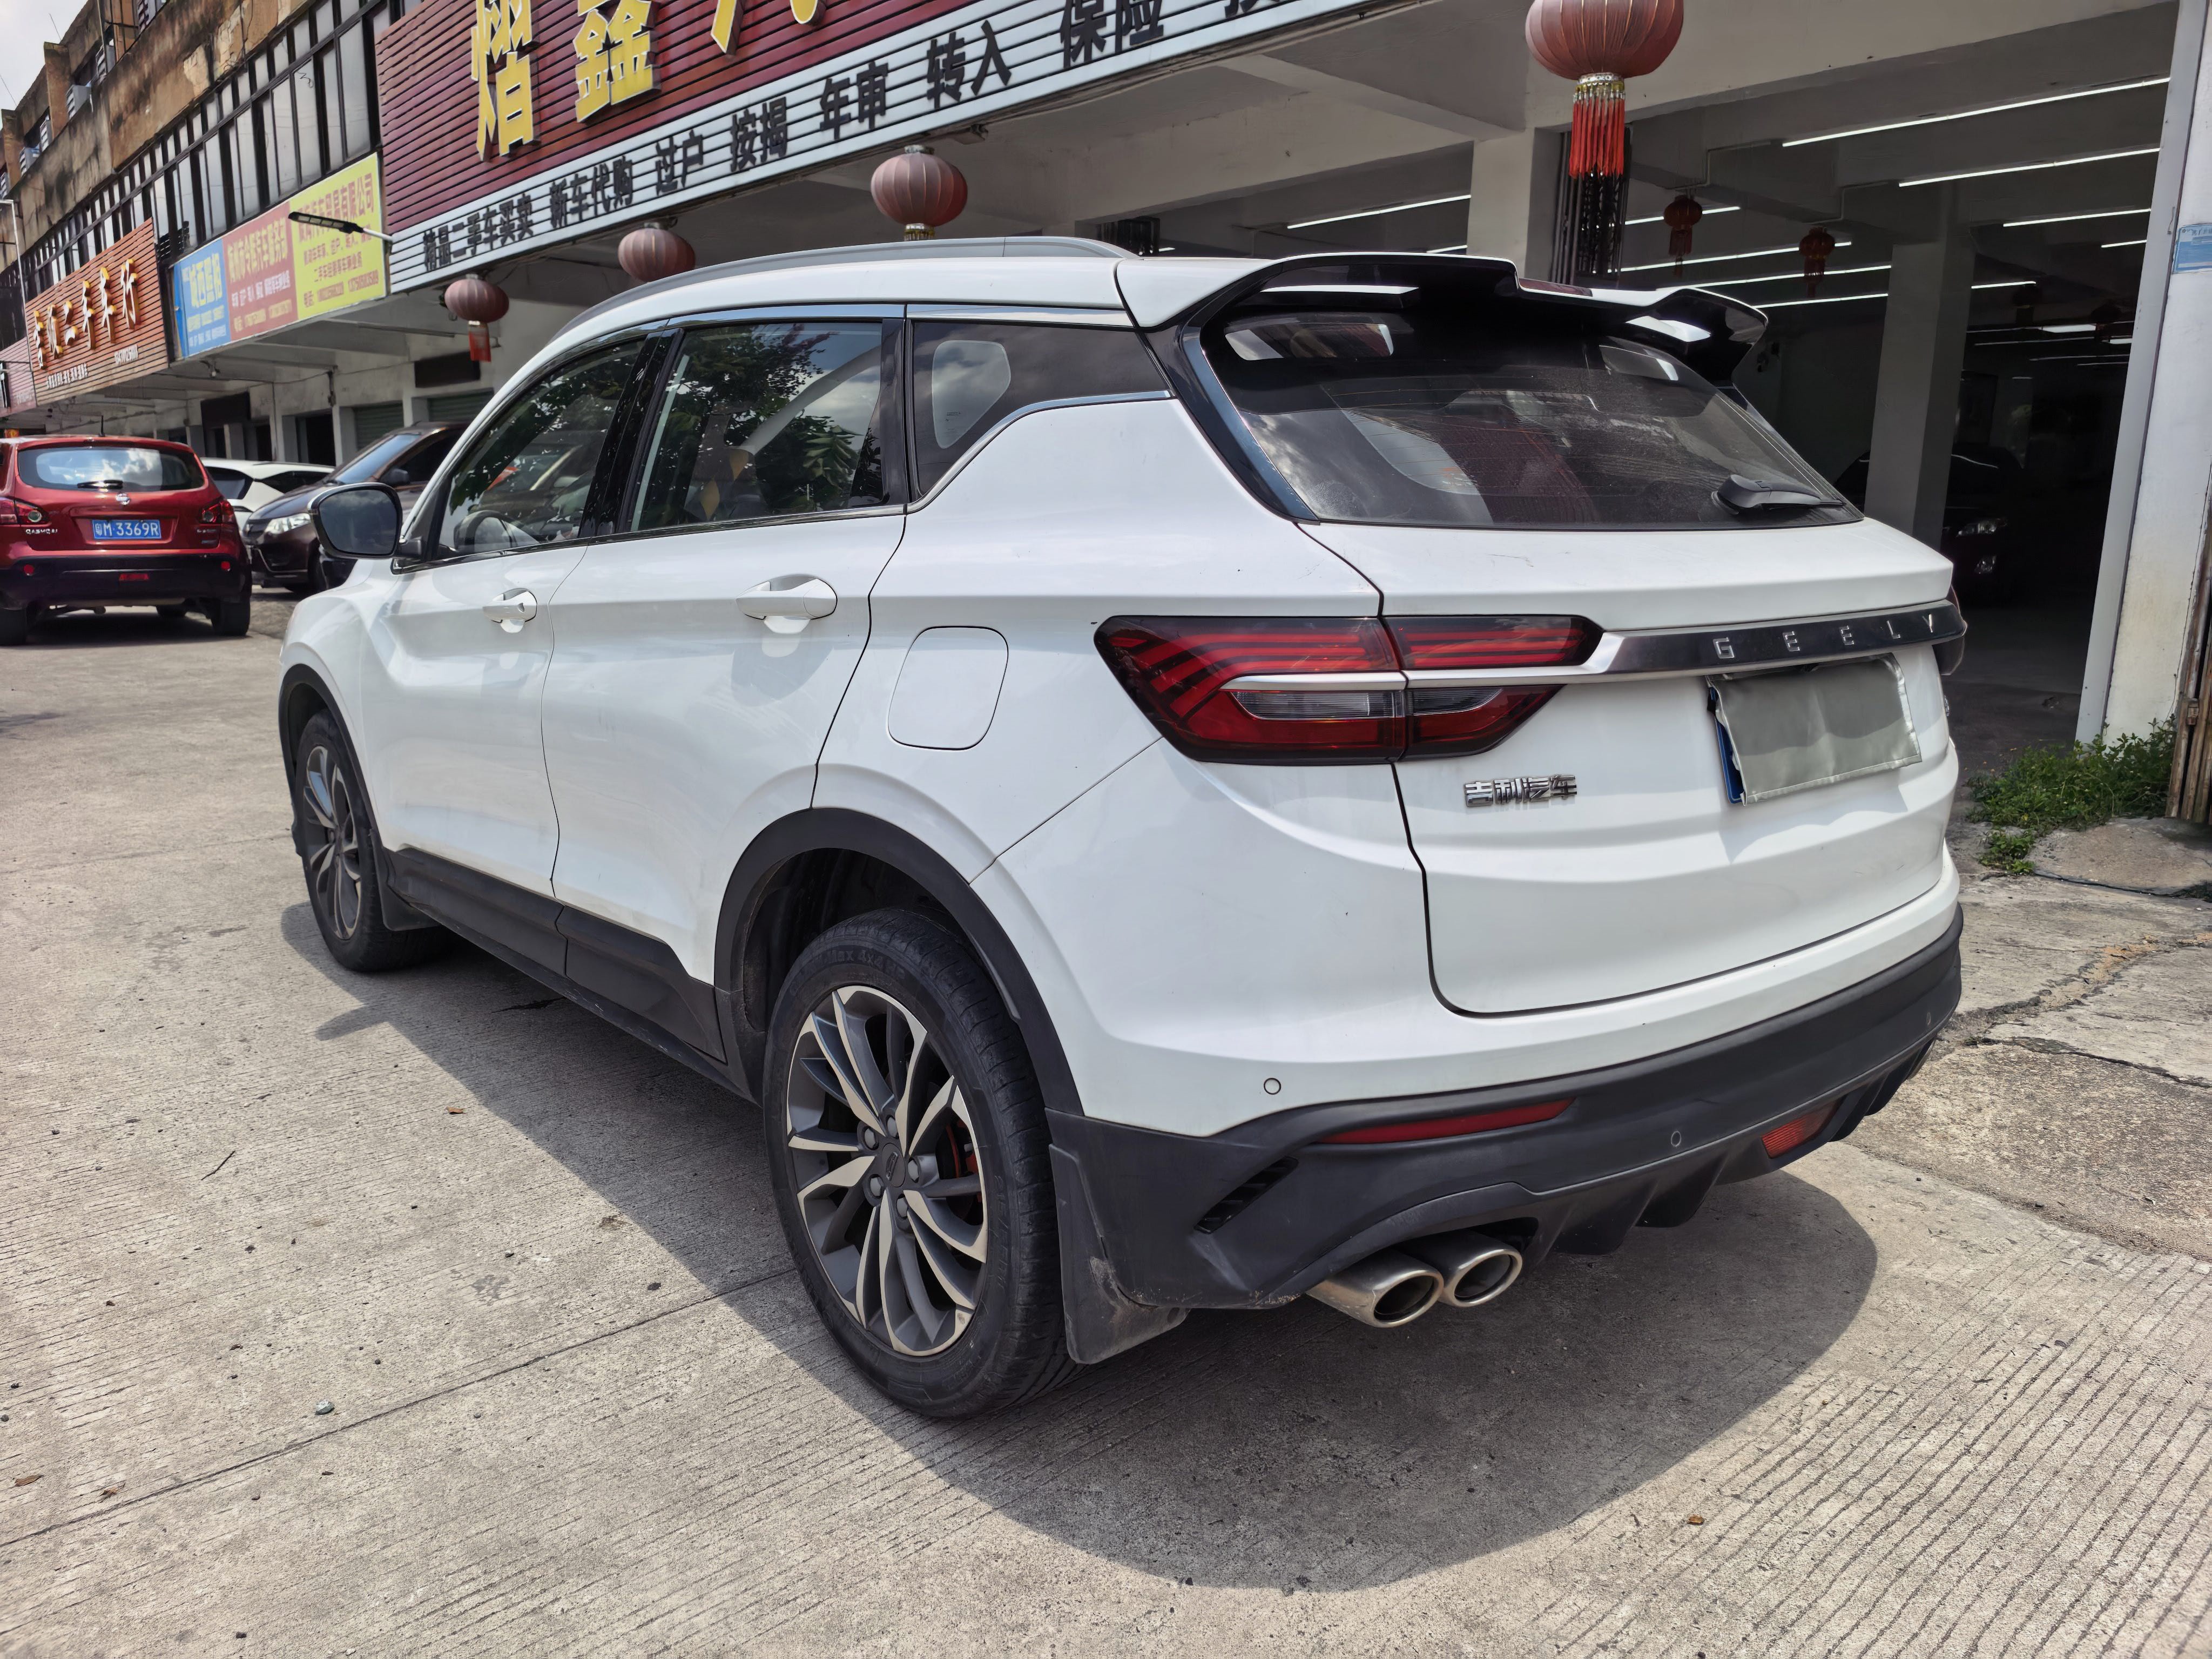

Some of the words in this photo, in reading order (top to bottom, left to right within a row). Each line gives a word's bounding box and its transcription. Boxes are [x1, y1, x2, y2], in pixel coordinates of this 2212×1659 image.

[423, 193, 534, 272] 精品二手车买卖
[549, 155, 633, 229] 新车代购
[655, 129, 705, 196] 过户
[730, 96, 789, 173] 按揭
[819, 60, 889, 140] 年审
[926, 19, 1011, 109] 转入
[1713, 613, 1933, 659] GEELY
[1464, 774, 1577, 807] 吉利汽车
